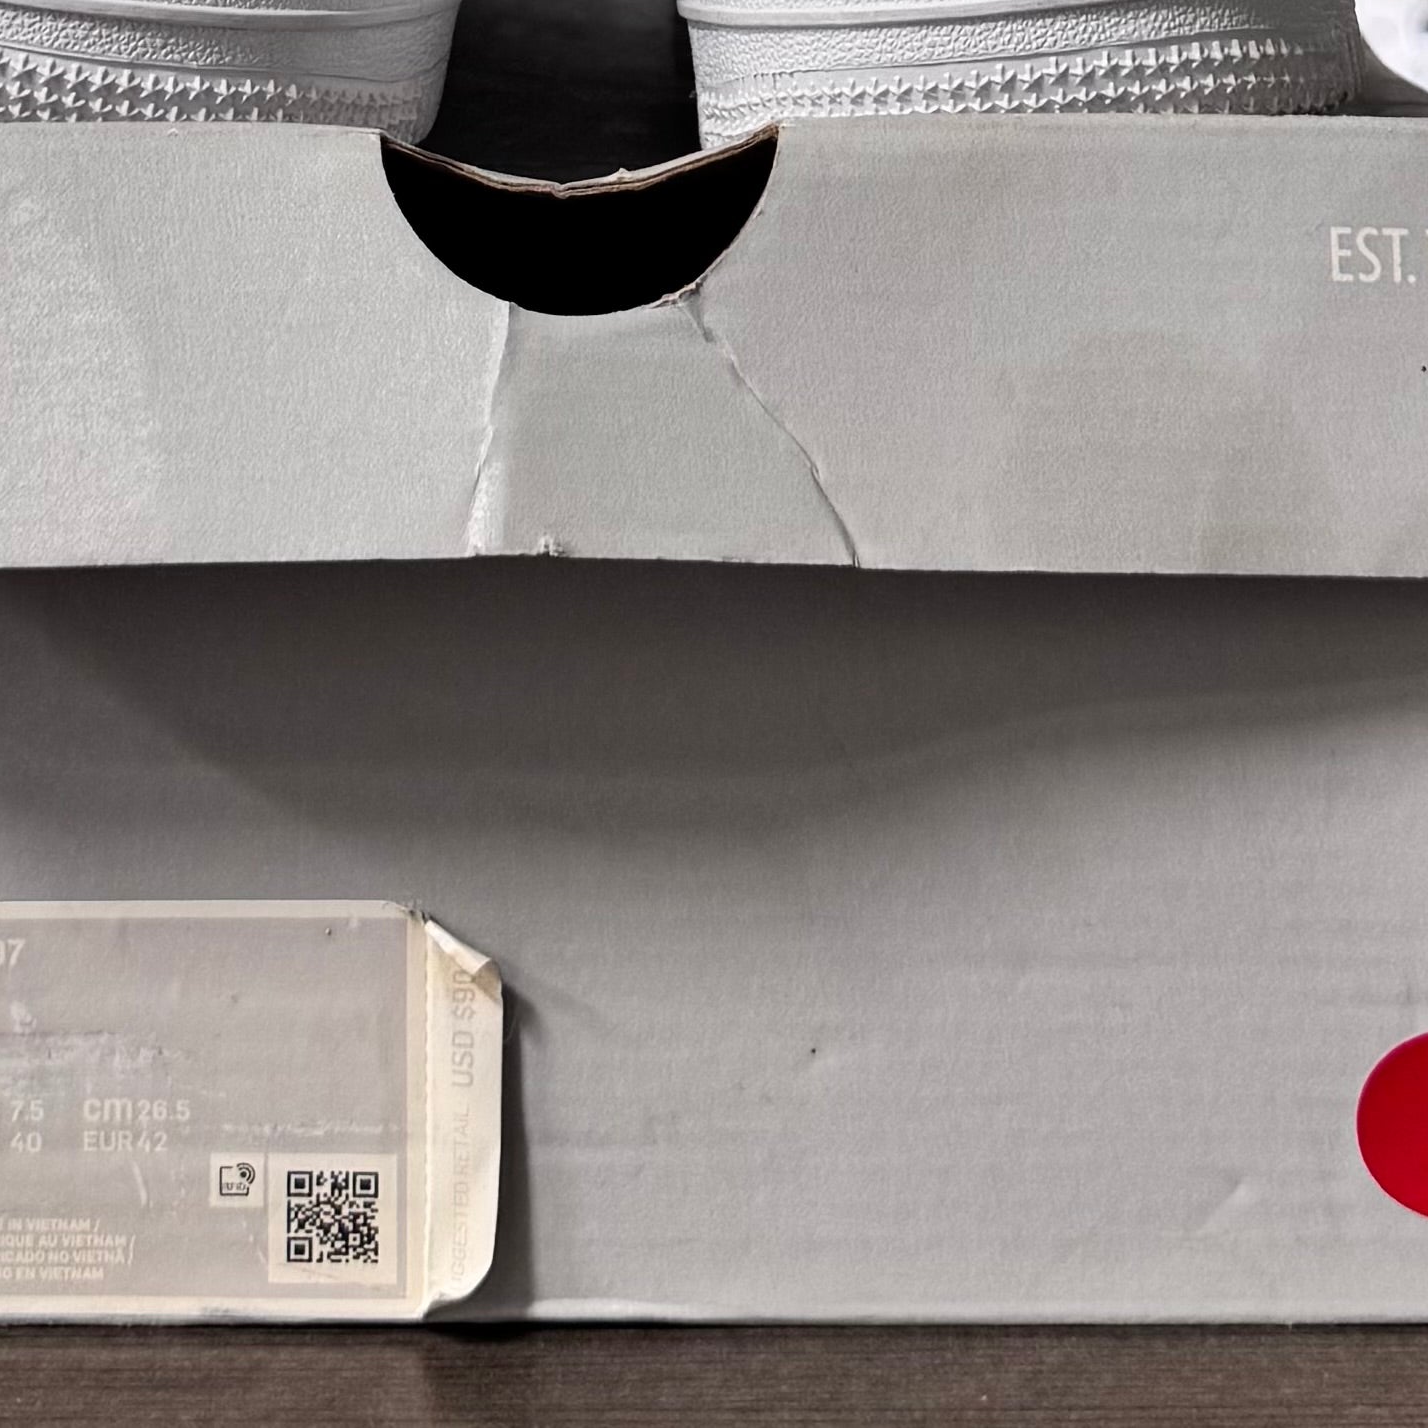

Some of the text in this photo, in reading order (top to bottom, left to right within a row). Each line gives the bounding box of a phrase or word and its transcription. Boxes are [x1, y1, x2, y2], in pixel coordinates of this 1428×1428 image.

[9, 1098, 45, 1122] 7.5
[9, 1130, 43, 1153] 40
[7, 1218, 23, 1232] IN
[25, 1217, 91, 1232] VIETNAM
[37, 1234, 58, 1248] AU
[61, 1234, 128, 1248] VIETNAM
[15, 1266, 36, 1281] EN
[39, 1266, 104, 1281] VIETNAM
